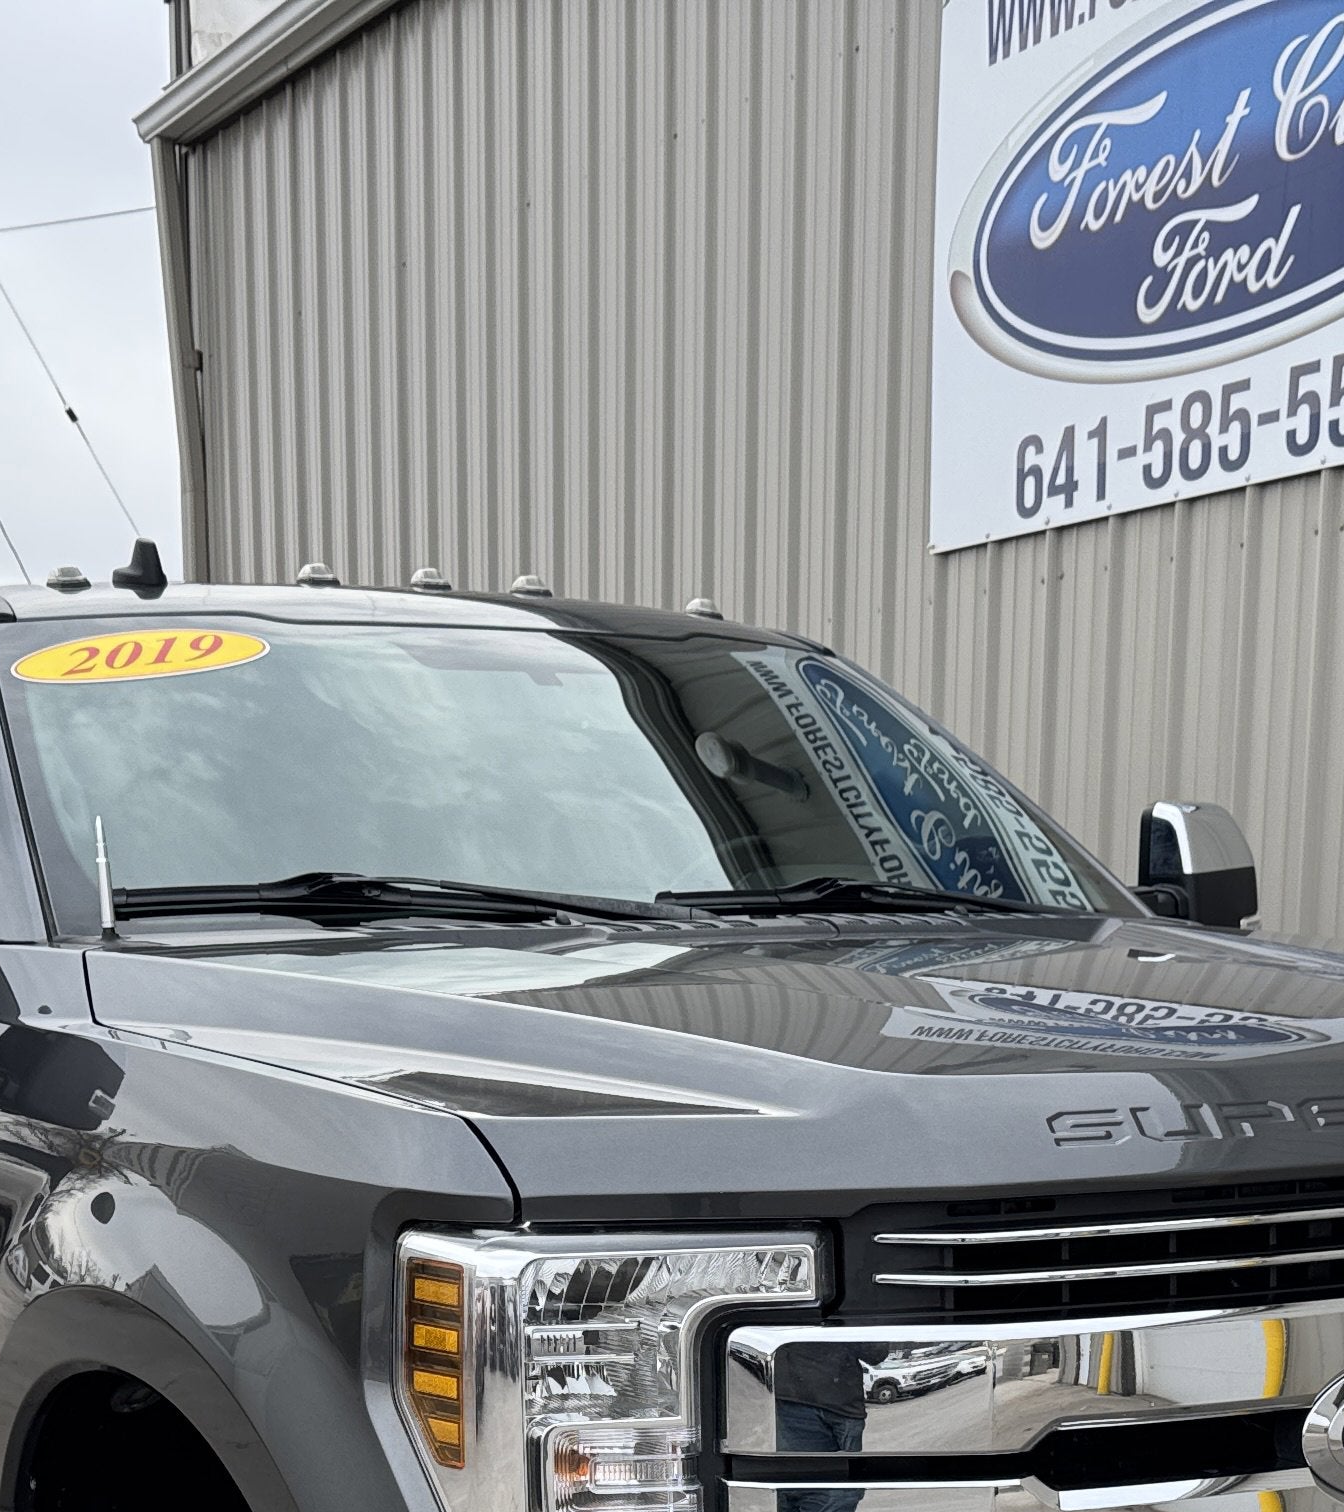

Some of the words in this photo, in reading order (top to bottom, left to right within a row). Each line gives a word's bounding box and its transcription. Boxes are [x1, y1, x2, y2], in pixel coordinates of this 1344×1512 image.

[1029, 89, 1253, 250] Forest
[1135, 193, 1302, 324] Ford
[61, 634, 224, 677] 2019
